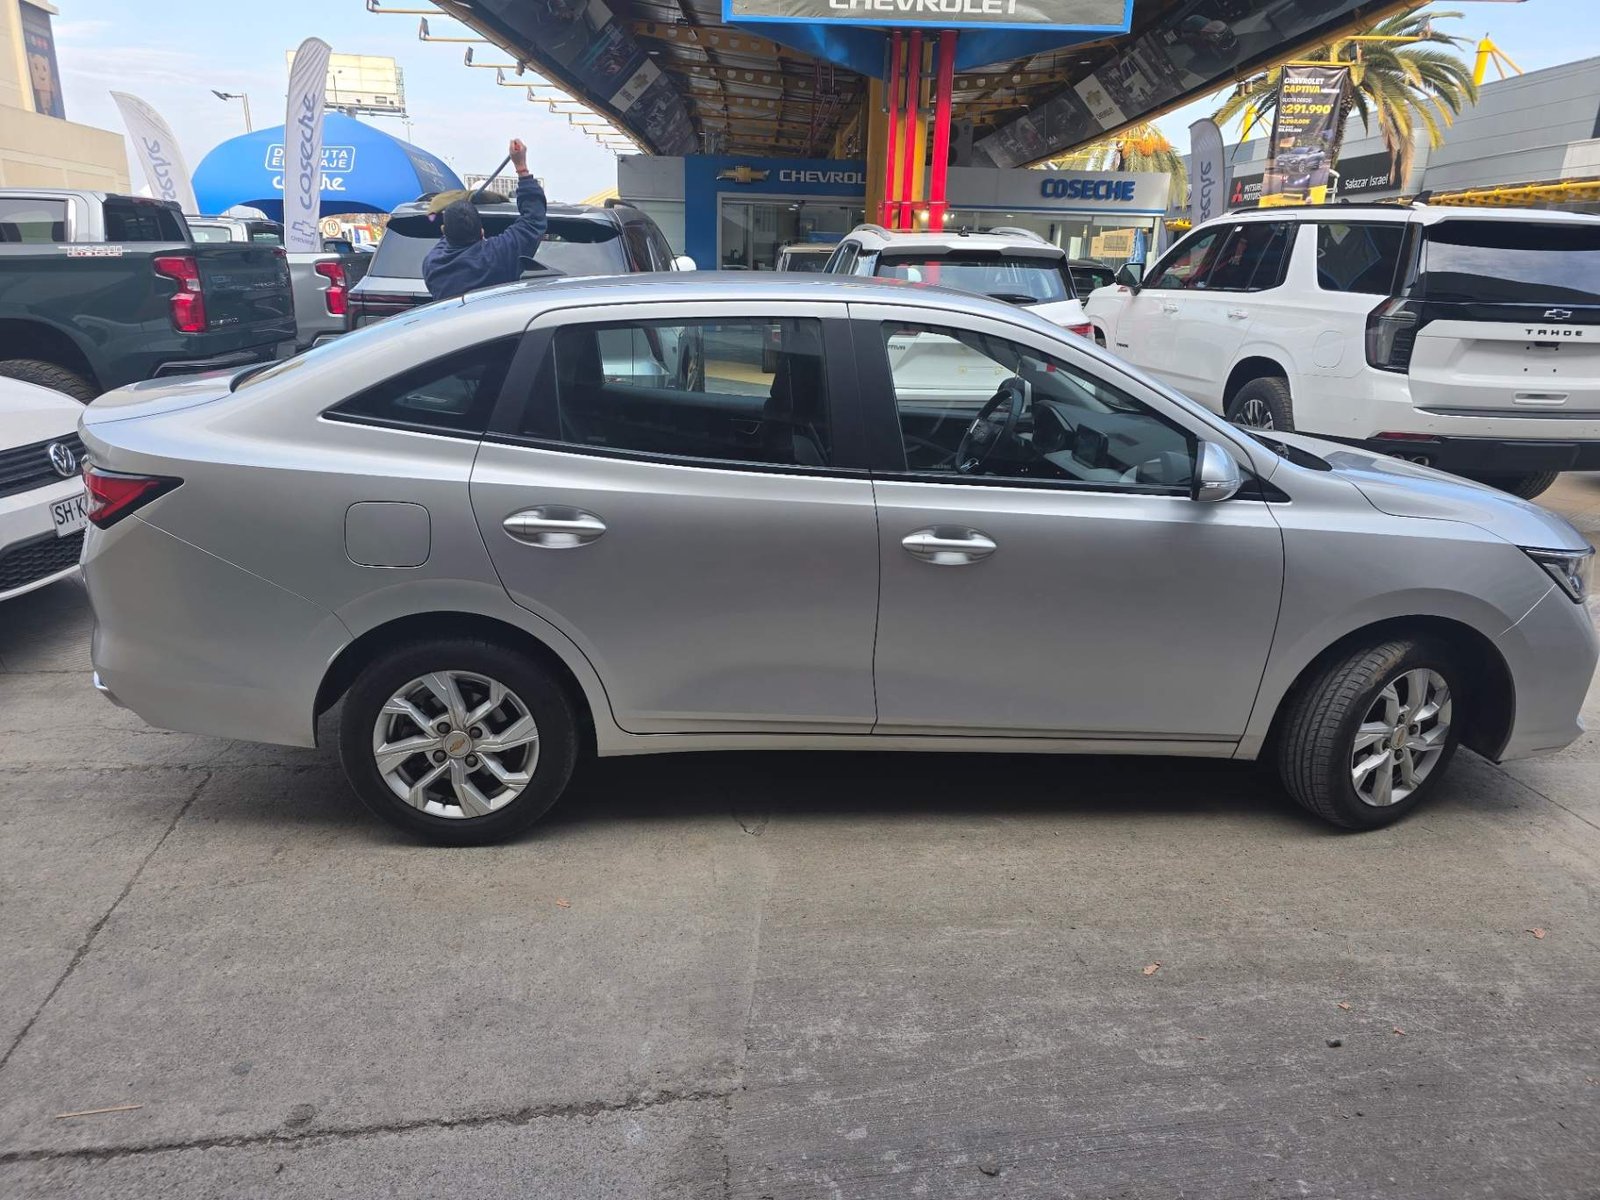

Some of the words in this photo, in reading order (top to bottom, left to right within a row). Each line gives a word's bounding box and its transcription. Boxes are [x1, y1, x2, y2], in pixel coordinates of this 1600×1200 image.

[1283, 85, 1320, 93] CAPTIVA
[298, 92, 317, 210] coseche
[779, 169, 867, 184] CHEVROL
[1344, 178, 1368, 190] Salazar
[1369, 174, 1389, 186] Israel
[1040, 178, 1136, 201] COSECHE
[1244, 183, 1262, 193] MITSUB
[1525, 328, 1583, 337] TAHOE
